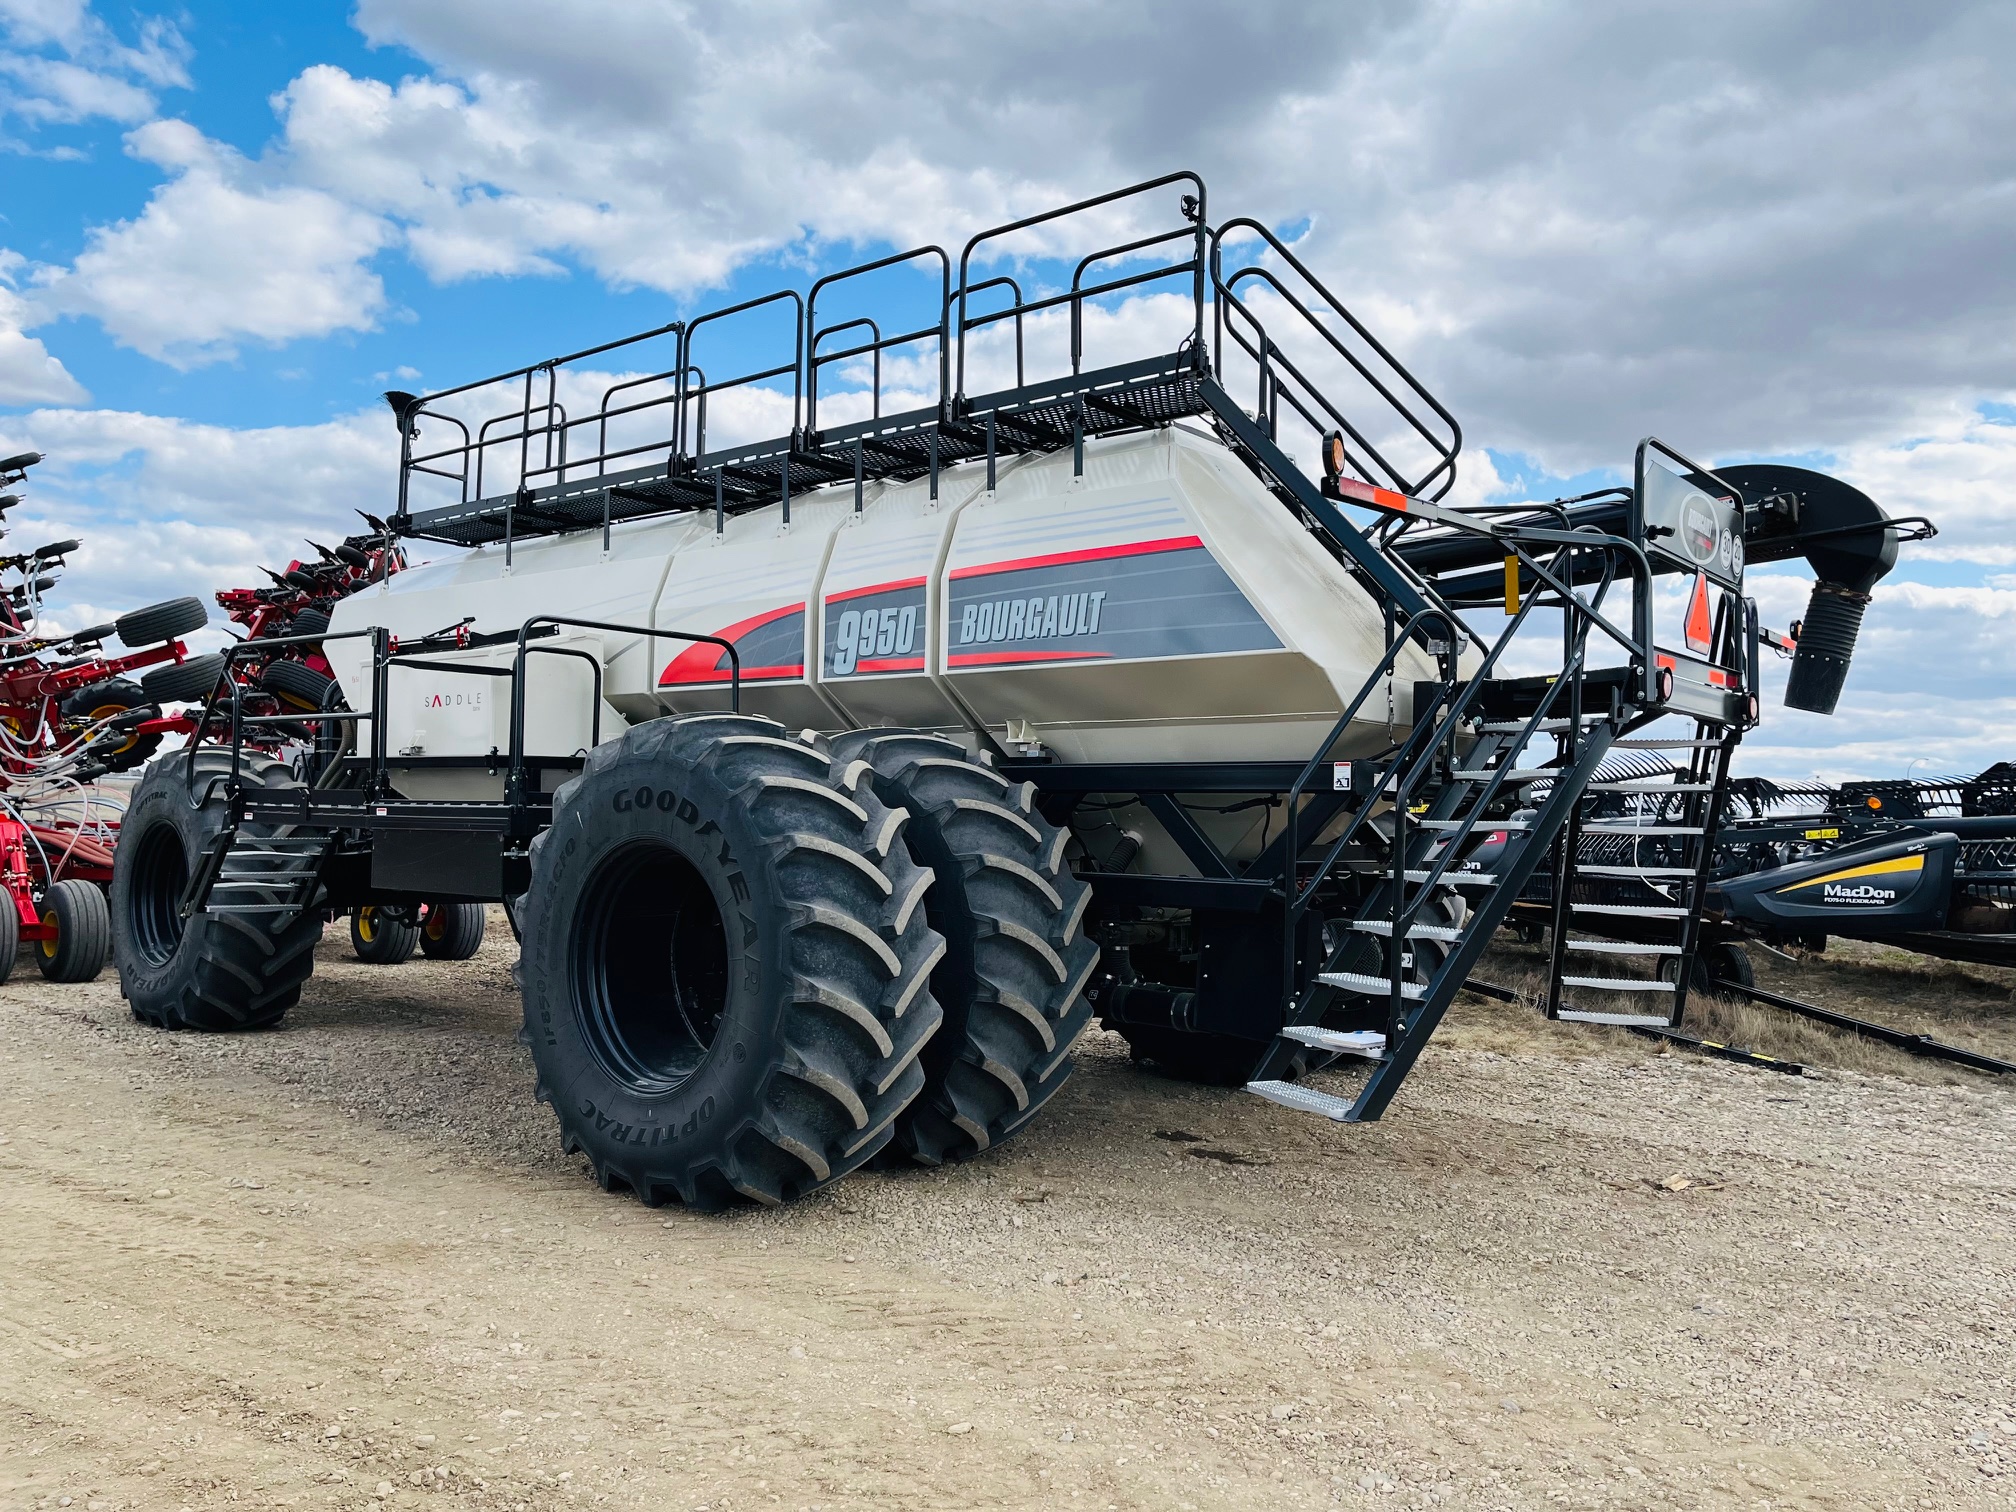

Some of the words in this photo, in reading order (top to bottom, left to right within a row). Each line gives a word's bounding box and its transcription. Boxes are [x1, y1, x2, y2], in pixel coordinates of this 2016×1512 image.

[833, 605, 918, 676] 9950
[959, 590, 1107, 645] BOURGAULT
[424, 692, 482, 708] SADDLE
[612, 786, 761, 996] GOODYEAR
[1823, 883, 1896, 899] MacDon
[578, 1095, 716, 1147] OPTITRAC
